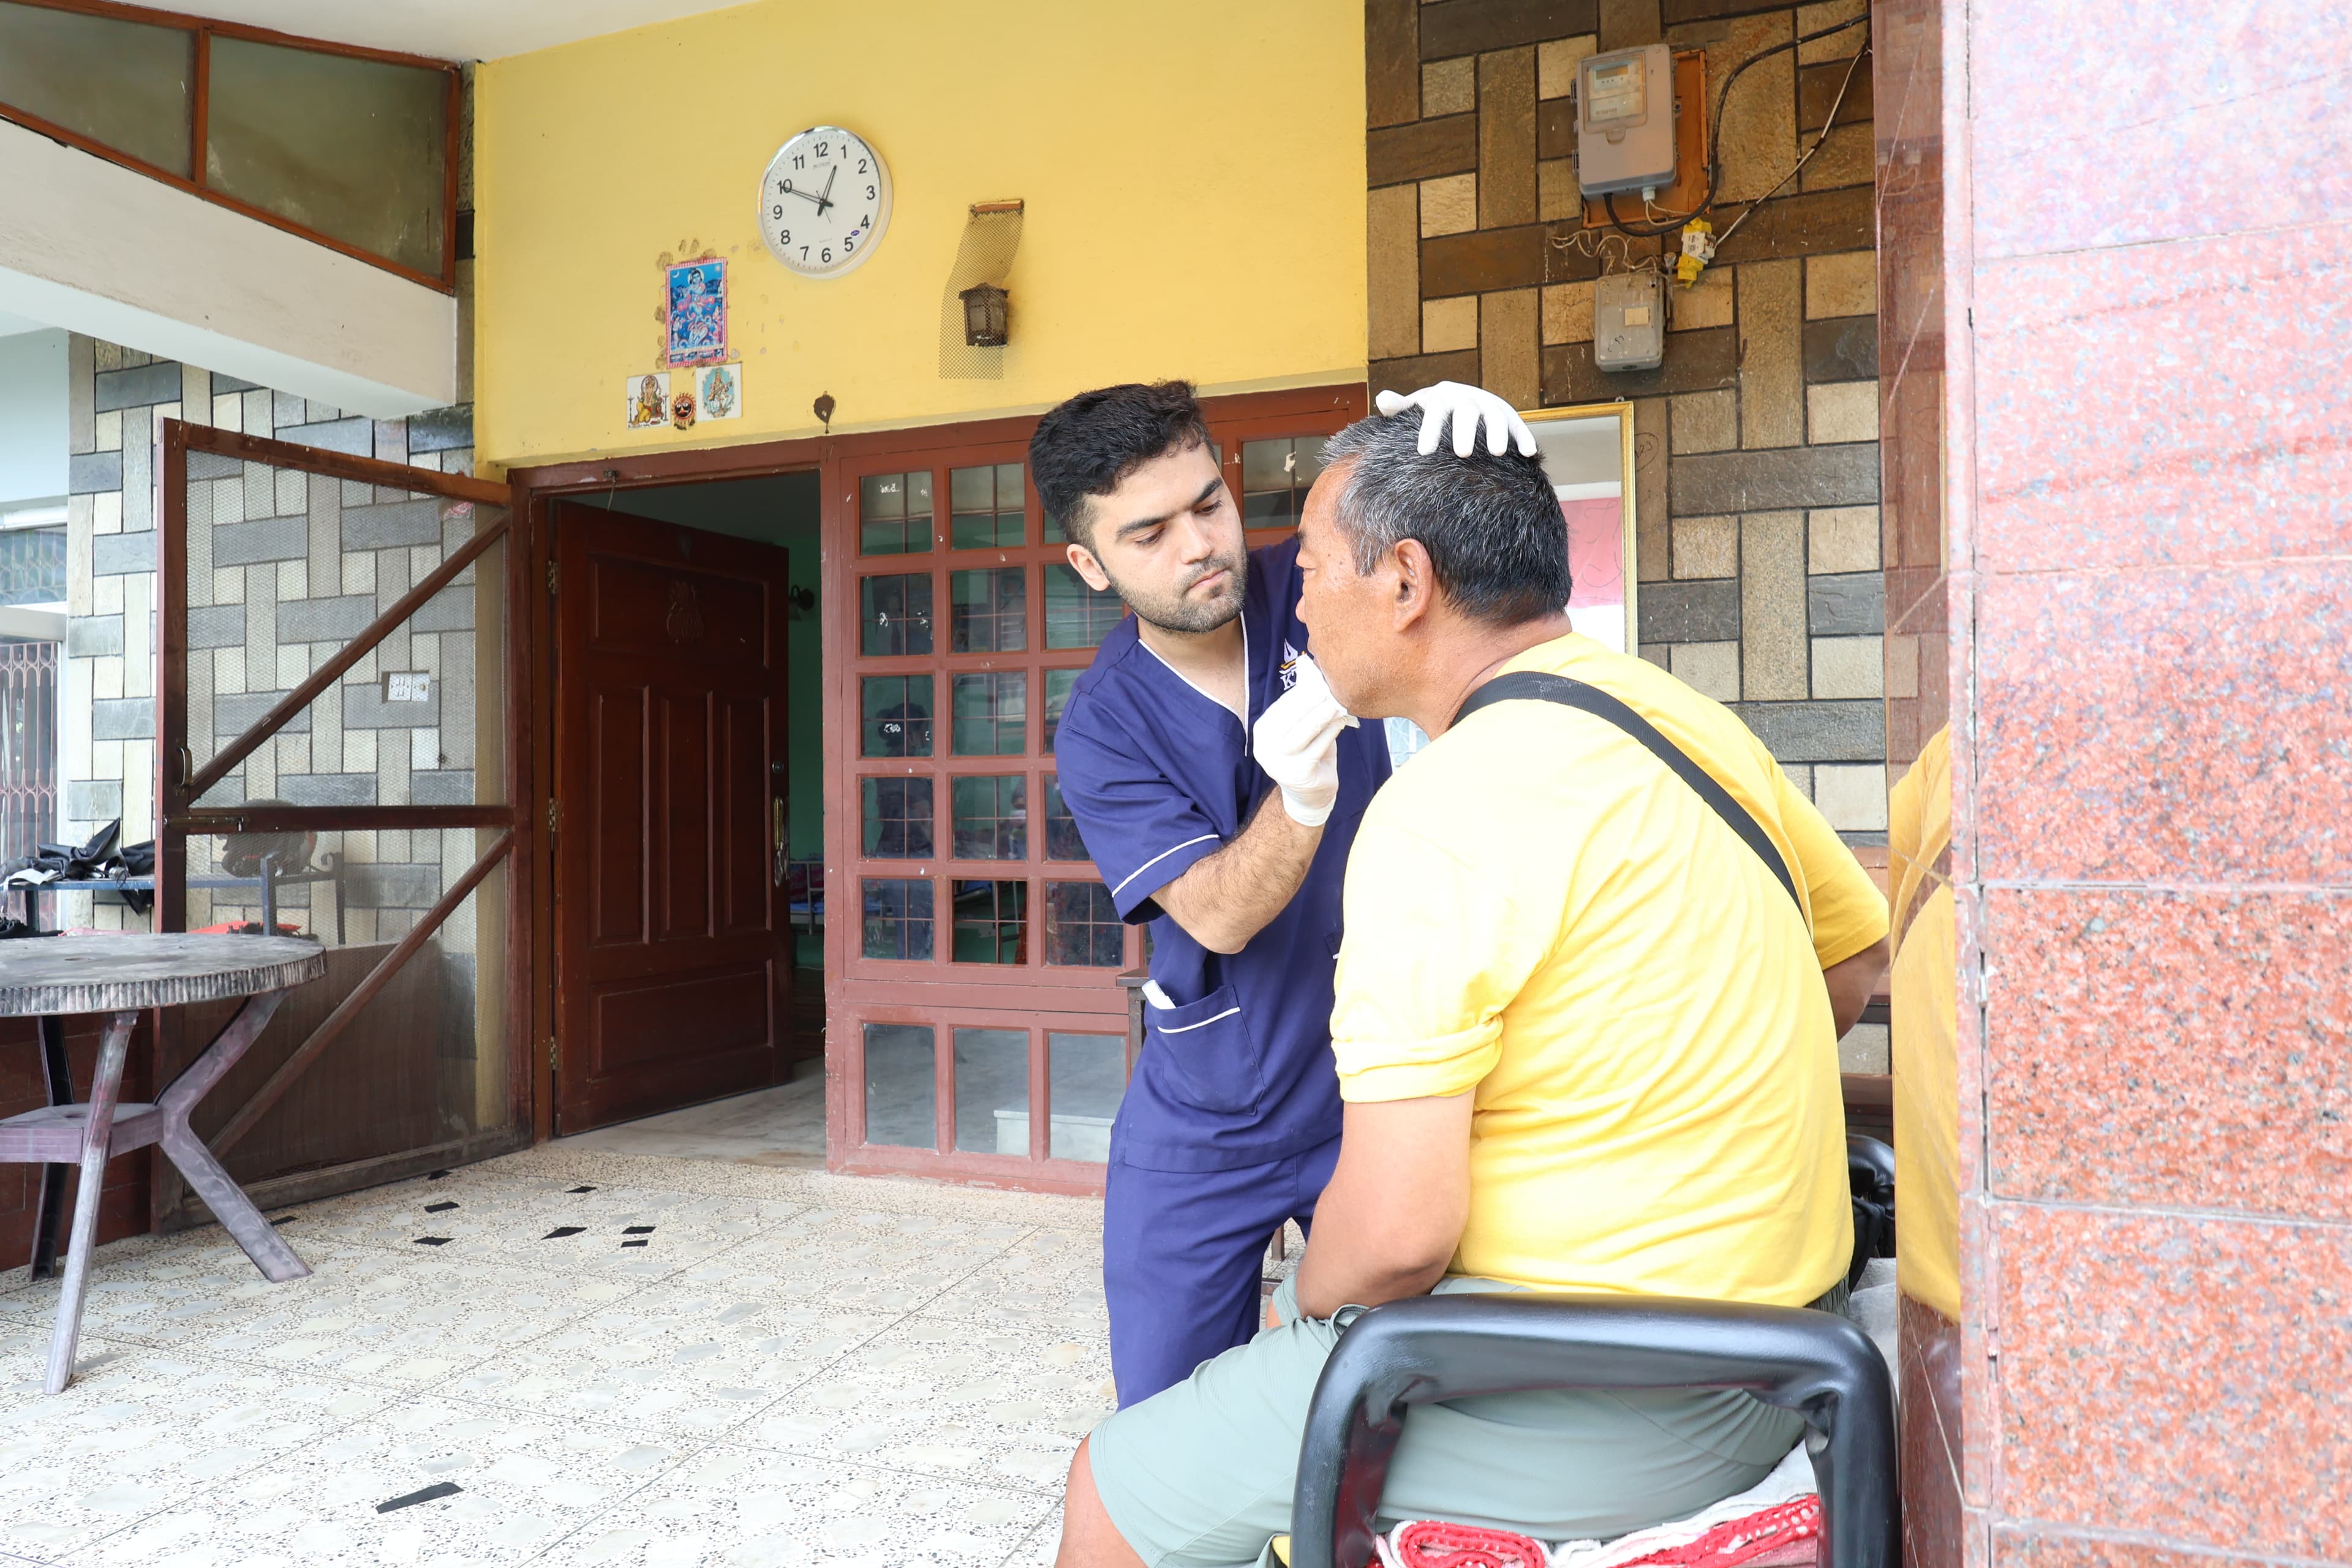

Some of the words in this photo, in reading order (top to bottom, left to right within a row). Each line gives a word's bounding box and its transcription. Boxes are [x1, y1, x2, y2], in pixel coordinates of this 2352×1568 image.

[813, 141, 828, 157] 12
[840, 145, 846, 159] 1
[793, 154, 804, 170] 11
[858, 159, 867, 174] 2
[777, 179, 793, 194] 10
[866, 185, 875, 200] 3
[773, 205, 783, 220] 9
[860, 214, 870, 229] 4
[781, 230, 791, 245] 8
[844, 236, 853, 252] 5
[800, 246, 809, 261] 7
[821, 247, 831, 263] 6
